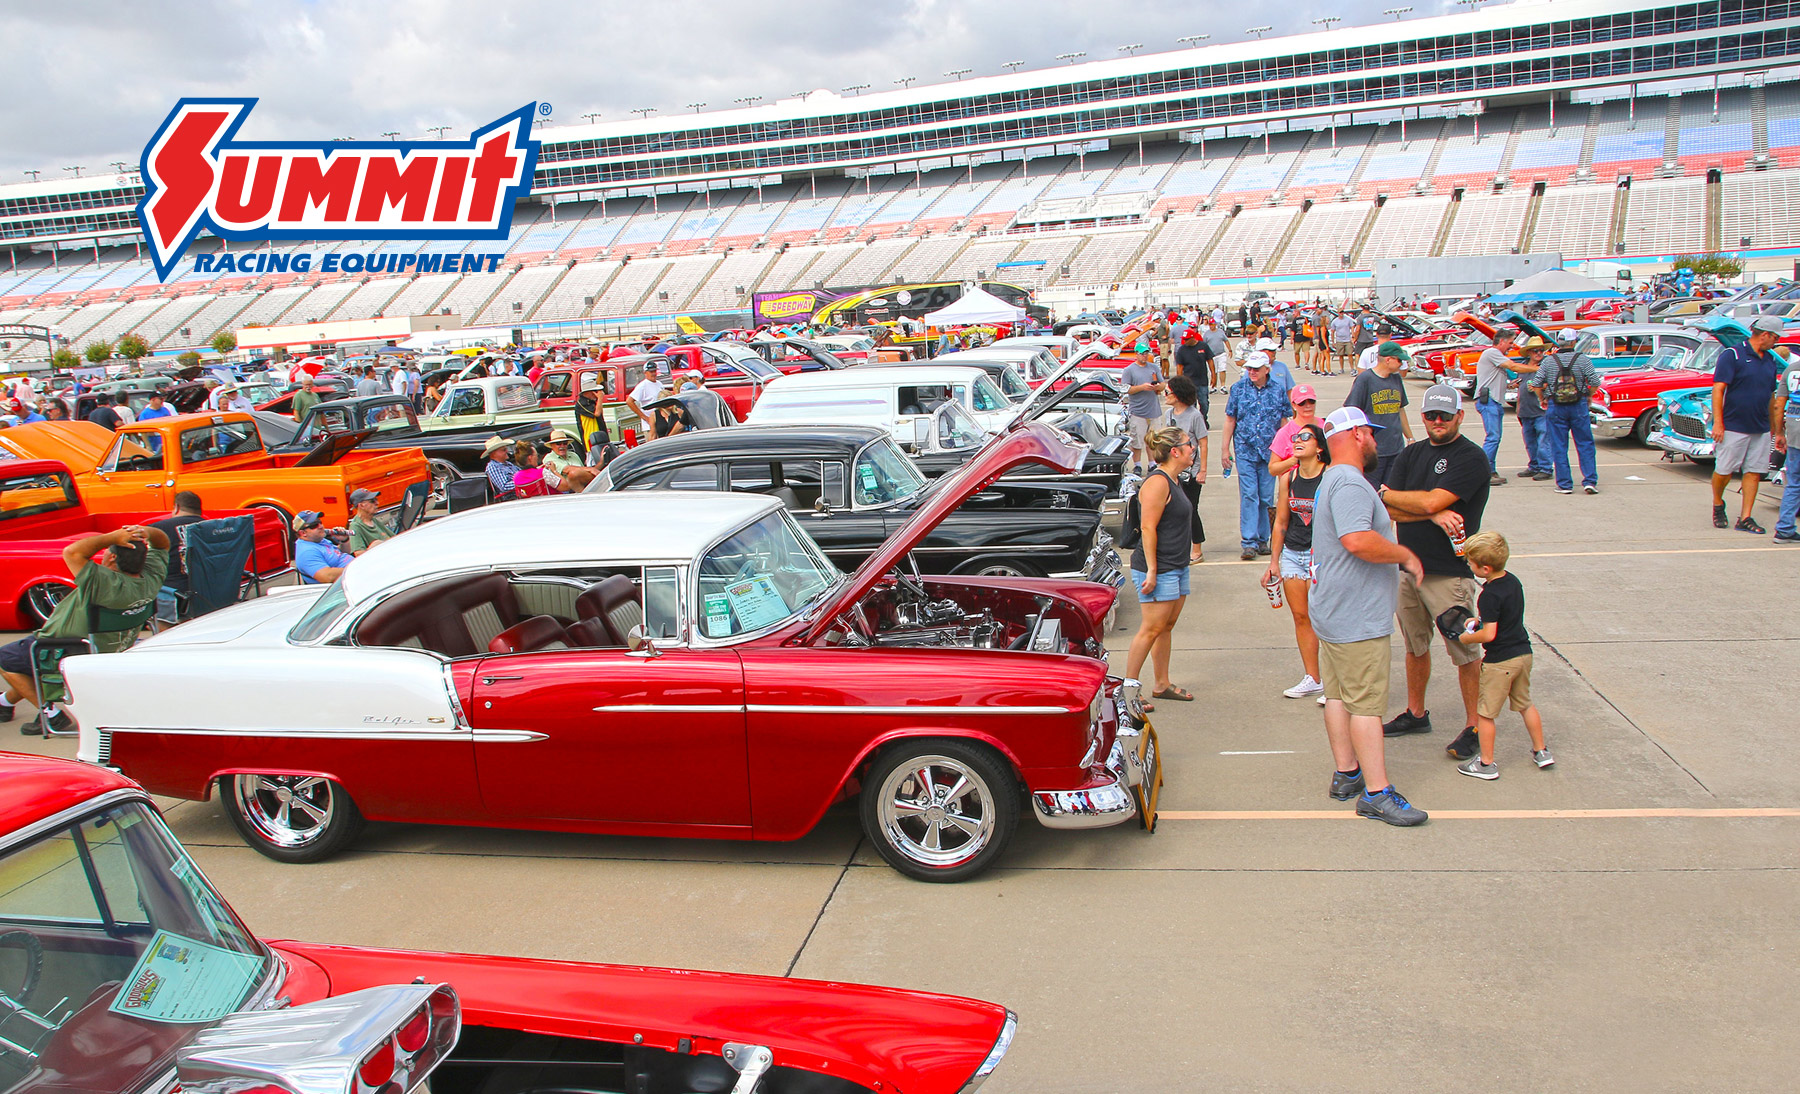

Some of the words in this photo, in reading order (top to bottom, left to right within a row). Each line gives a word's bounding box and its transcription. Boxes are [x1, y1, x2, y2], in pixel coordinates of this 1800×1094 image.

[129, 176, 143, 184] TE
[771, 299, 814, 312] SPEEDWAY
[1432, 394, 1453, 403] Columbia
[710, 614, 728, 622] 1086
[124, 968, 158, 1009] GOODGUYS
